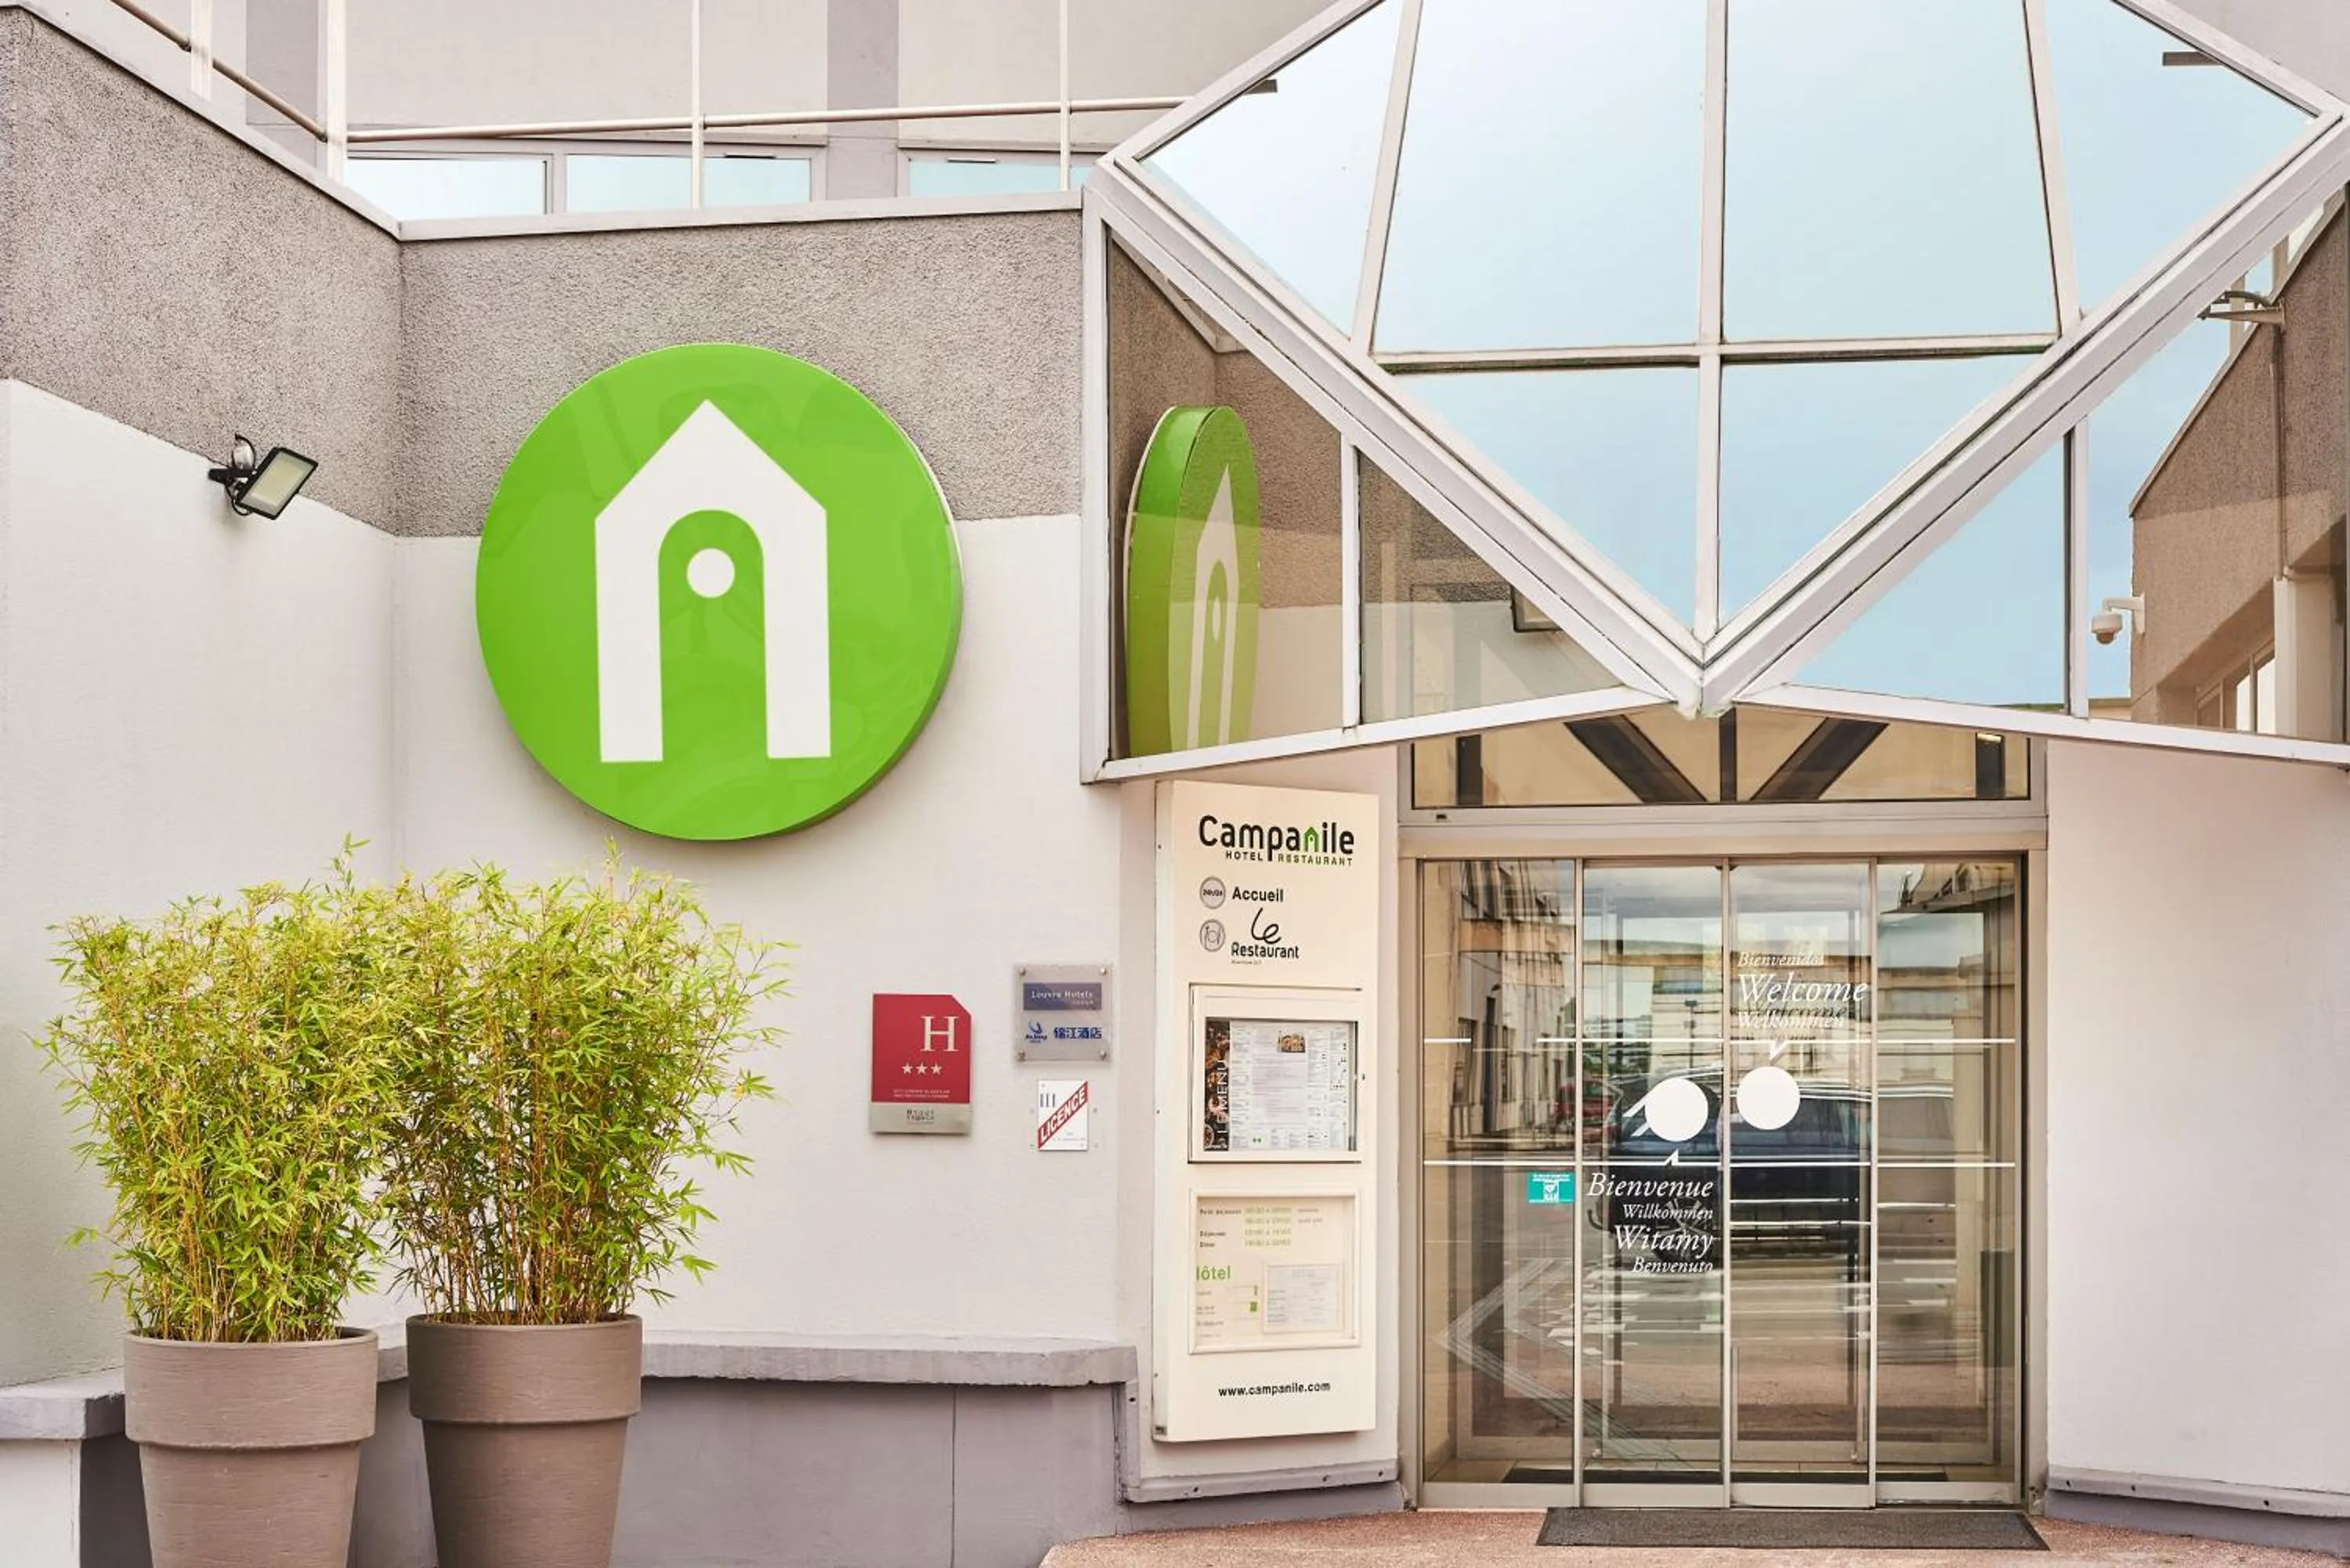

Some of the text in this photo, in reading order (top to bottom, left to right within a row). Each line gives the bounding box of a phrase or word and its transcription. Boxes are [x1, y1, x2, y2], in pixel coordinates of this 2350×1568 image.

[1198, 815, 1355, 862] Campanile
[1225, 851, 1354, 867] HOTEL RESTAURANT
[1232, 886, 1284, 902] Accueil
[1231, 941, 1300, 959] Restaurant
[1737, 971, 1869, 1003] Welcome
[919, 1016, 960, 1053] H
[1039, 1085, 1086, 1143] LICENCE
[1587, 1172, 1714, 1198] Bienvenue
[1622, 1202, 1714, 1219] Willkommen
[1614, 1224, 1714, 1259] Witamy
[1632, 1256, 1714, 1273] Benvenuto
[1218, 1382, 1331, 1396] www.campanile.com
